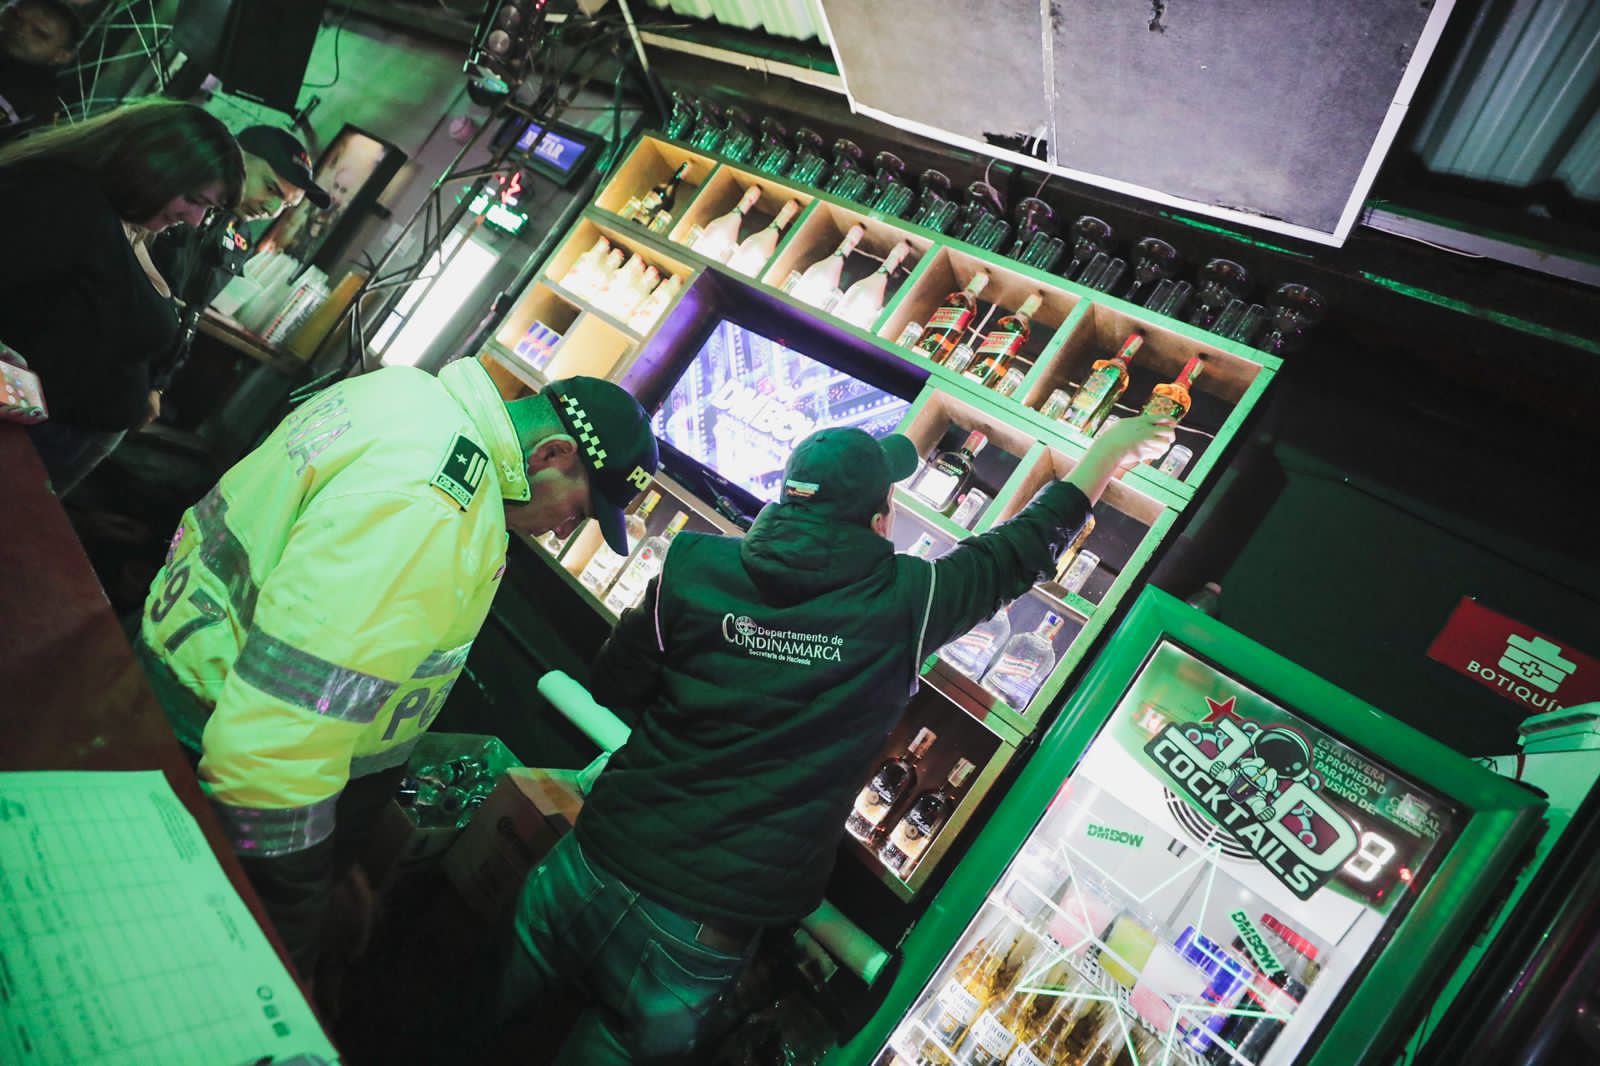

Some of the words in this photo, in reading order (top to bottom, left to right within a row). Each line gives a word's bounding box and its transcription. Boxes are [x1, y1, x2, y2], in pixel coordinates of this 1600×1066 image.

[722, 612, 841, 662] CUNDINAMARCA
[758, 627, 828, 643] Departamento
[831, 635, 844, 646] de
[1466, 659, 1563, 712] BOTIQUÍ
[1315, 760, 1343, 779] PARA
[1344, 775, 1369, 797] USO
[1317, 738, 1342, 757] ESTA
[1343, 751, 1386, 782] NEVERA
[1326, 755, 1387, 795] PROPIEDAD
[1153, 739, 1318, 892] COCKTAILS
